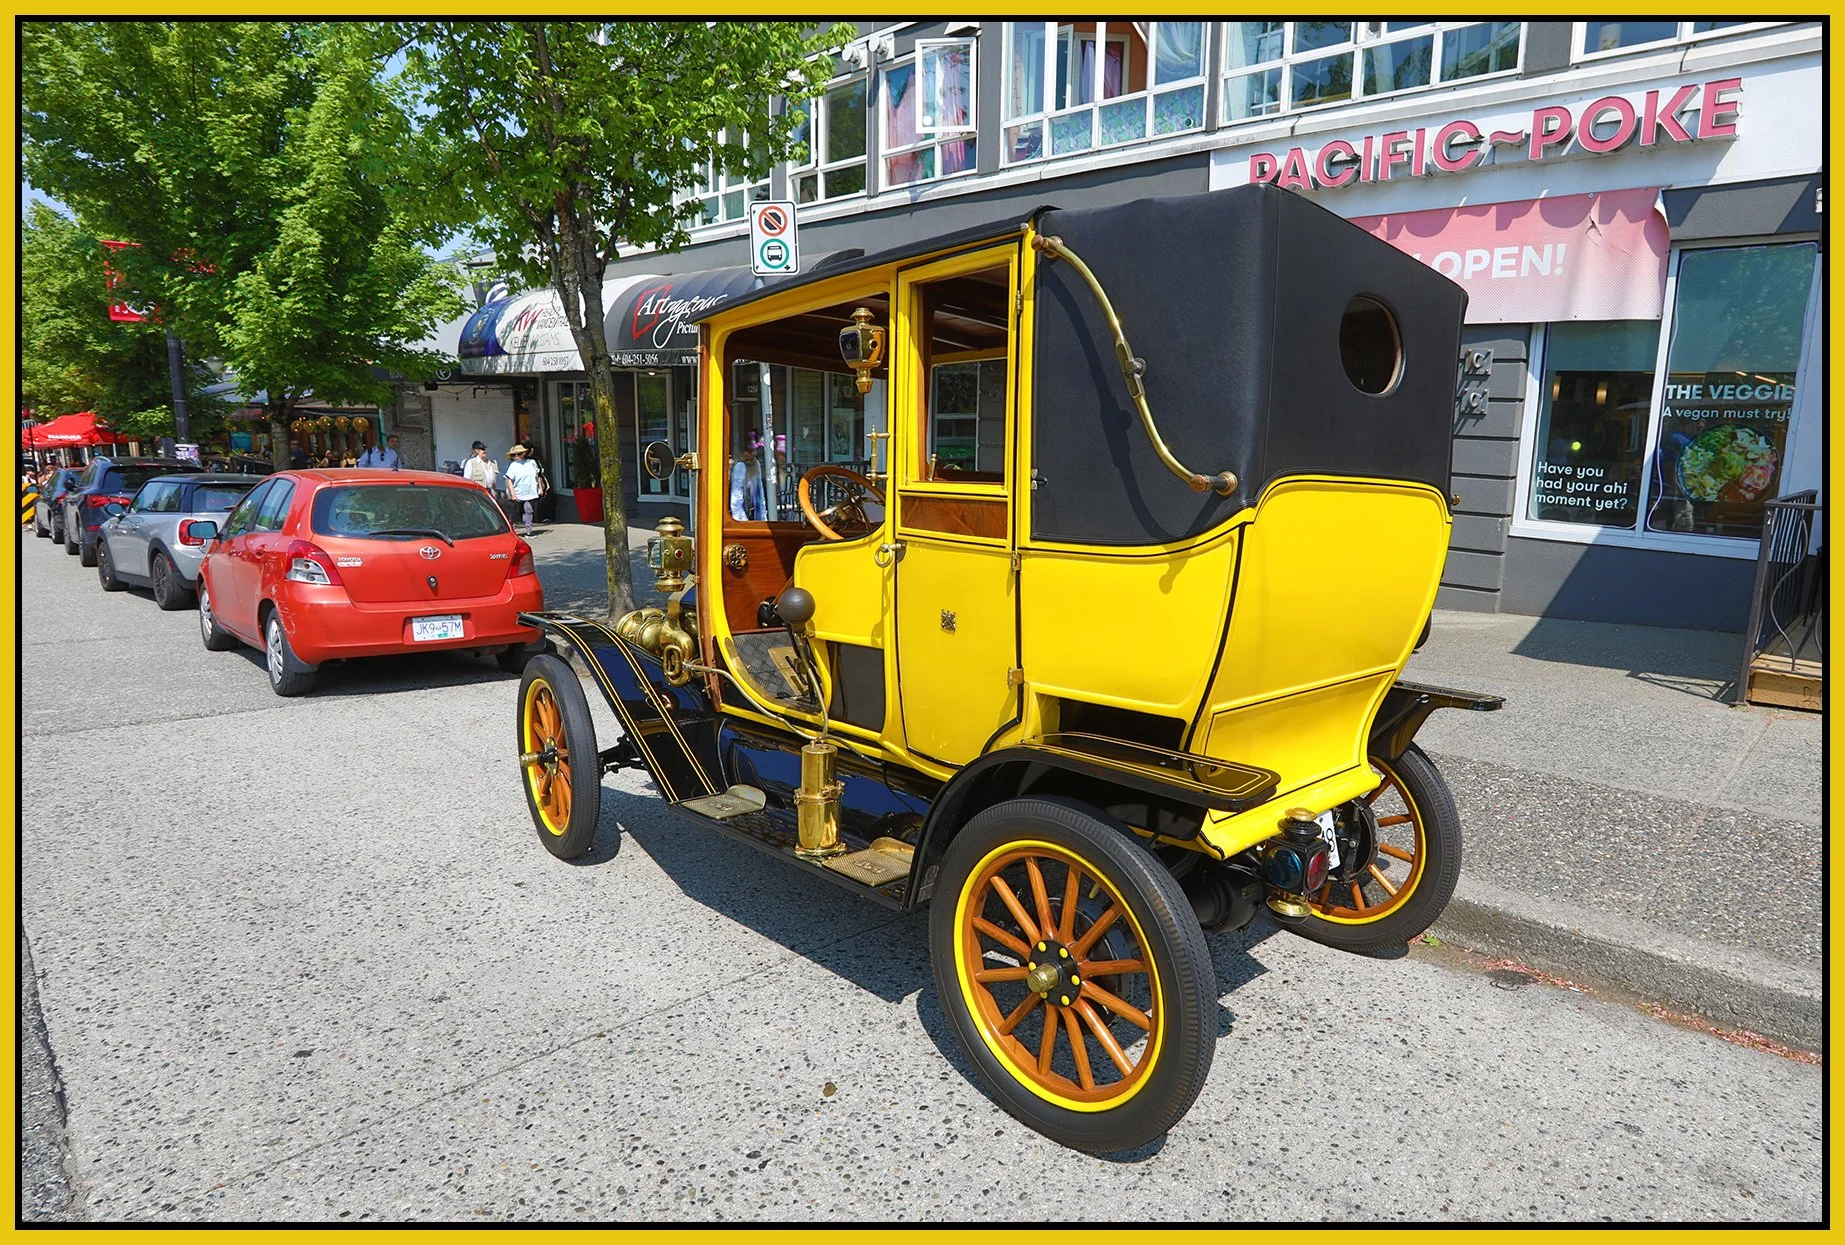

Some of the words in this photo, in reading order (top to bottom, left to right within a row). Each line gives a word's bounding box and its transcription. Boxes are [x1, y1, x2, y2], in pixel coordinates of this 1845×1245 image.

[1431, 243, 1567, 280] OPEN!
[1666, 384, 1703, 400] THE
[1709, 384, 1794, 400] VEGGIE
[1662, 406, 1672, 417] A
[1676, 409, 1719, 420] vegan
[1723, 407, 1761, 419] must
[1764, 407, 1791, 422] try!
[1537, 461, 1573, 475] Have
[1577, 467, 1604, 479] you
[1536, 476, 1563, 490] had
[1566, 482, 1600, 493] your
[1603, 481, 1628, 494] ahi
[1534, 493, 1591, 507] moment
[1595, 497, 1628, 511] yet?
